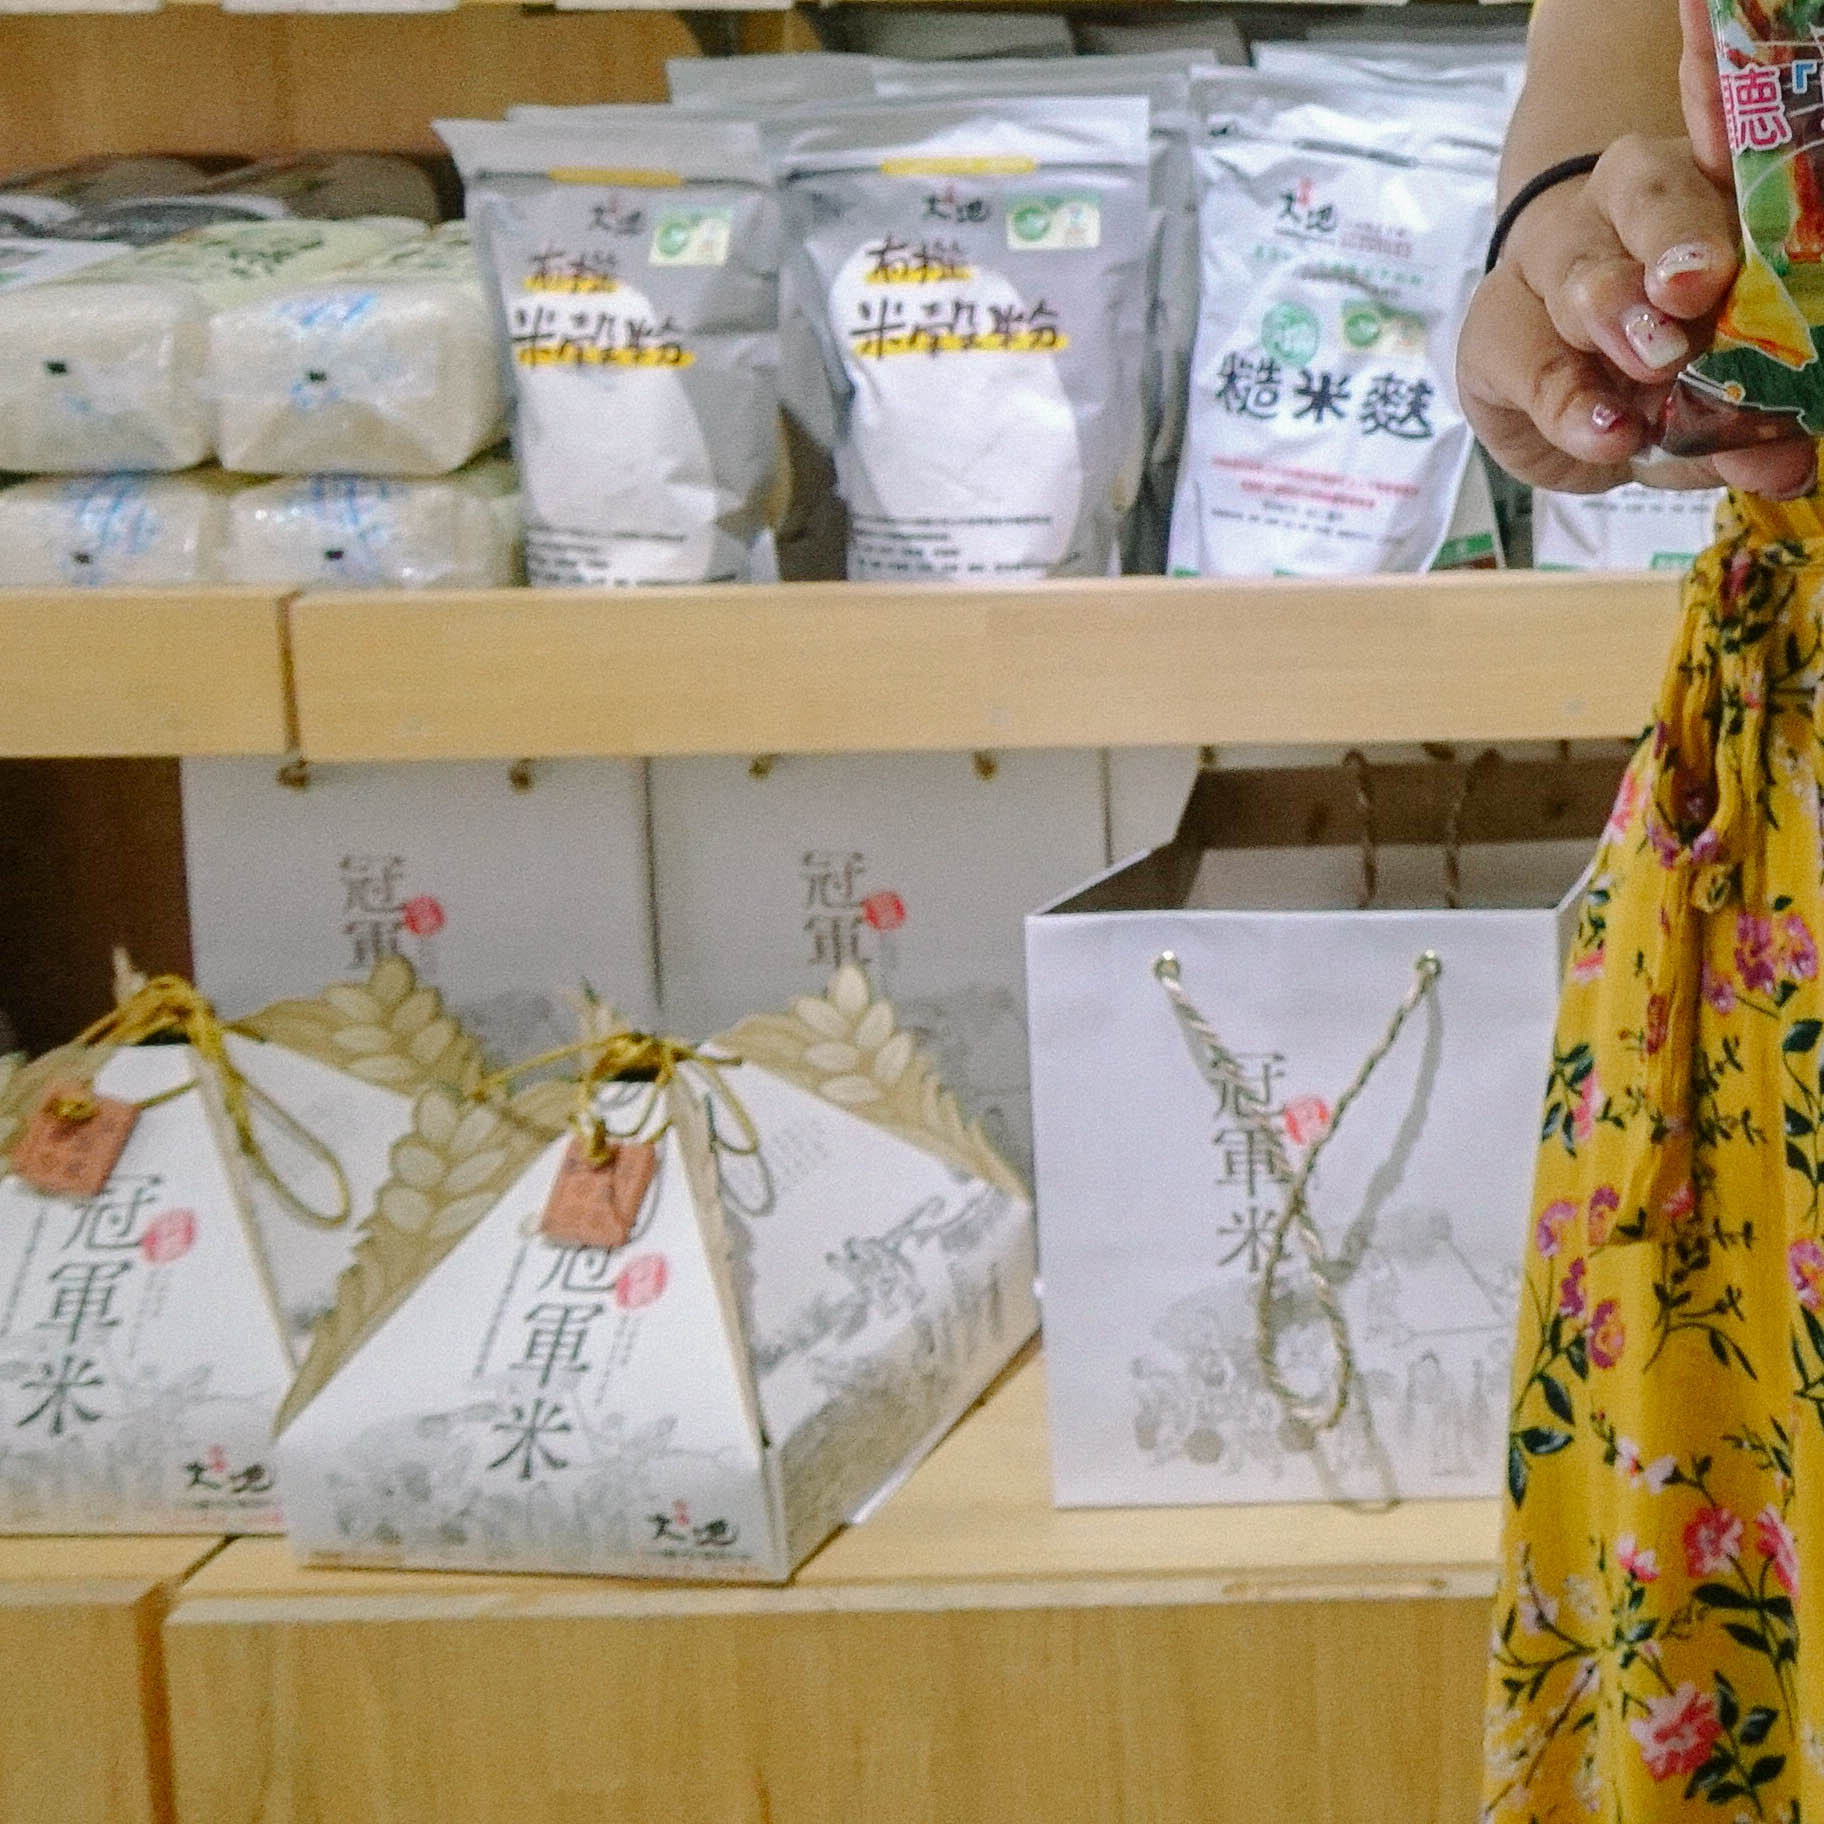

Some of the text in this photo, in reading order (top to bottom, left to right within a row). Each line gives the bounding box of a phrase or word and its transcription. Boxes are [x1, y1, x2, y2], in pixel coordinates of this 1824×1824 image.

[848, 298, 1060, 360] 米穀粉
[340, 852, 409, 973] 冠軍
[802, 848, 872, 970] 冠軍
[1212, 1051, 1294, 1275] 冠軍米
[16, 1174, 164, 1436] 冠軍米
